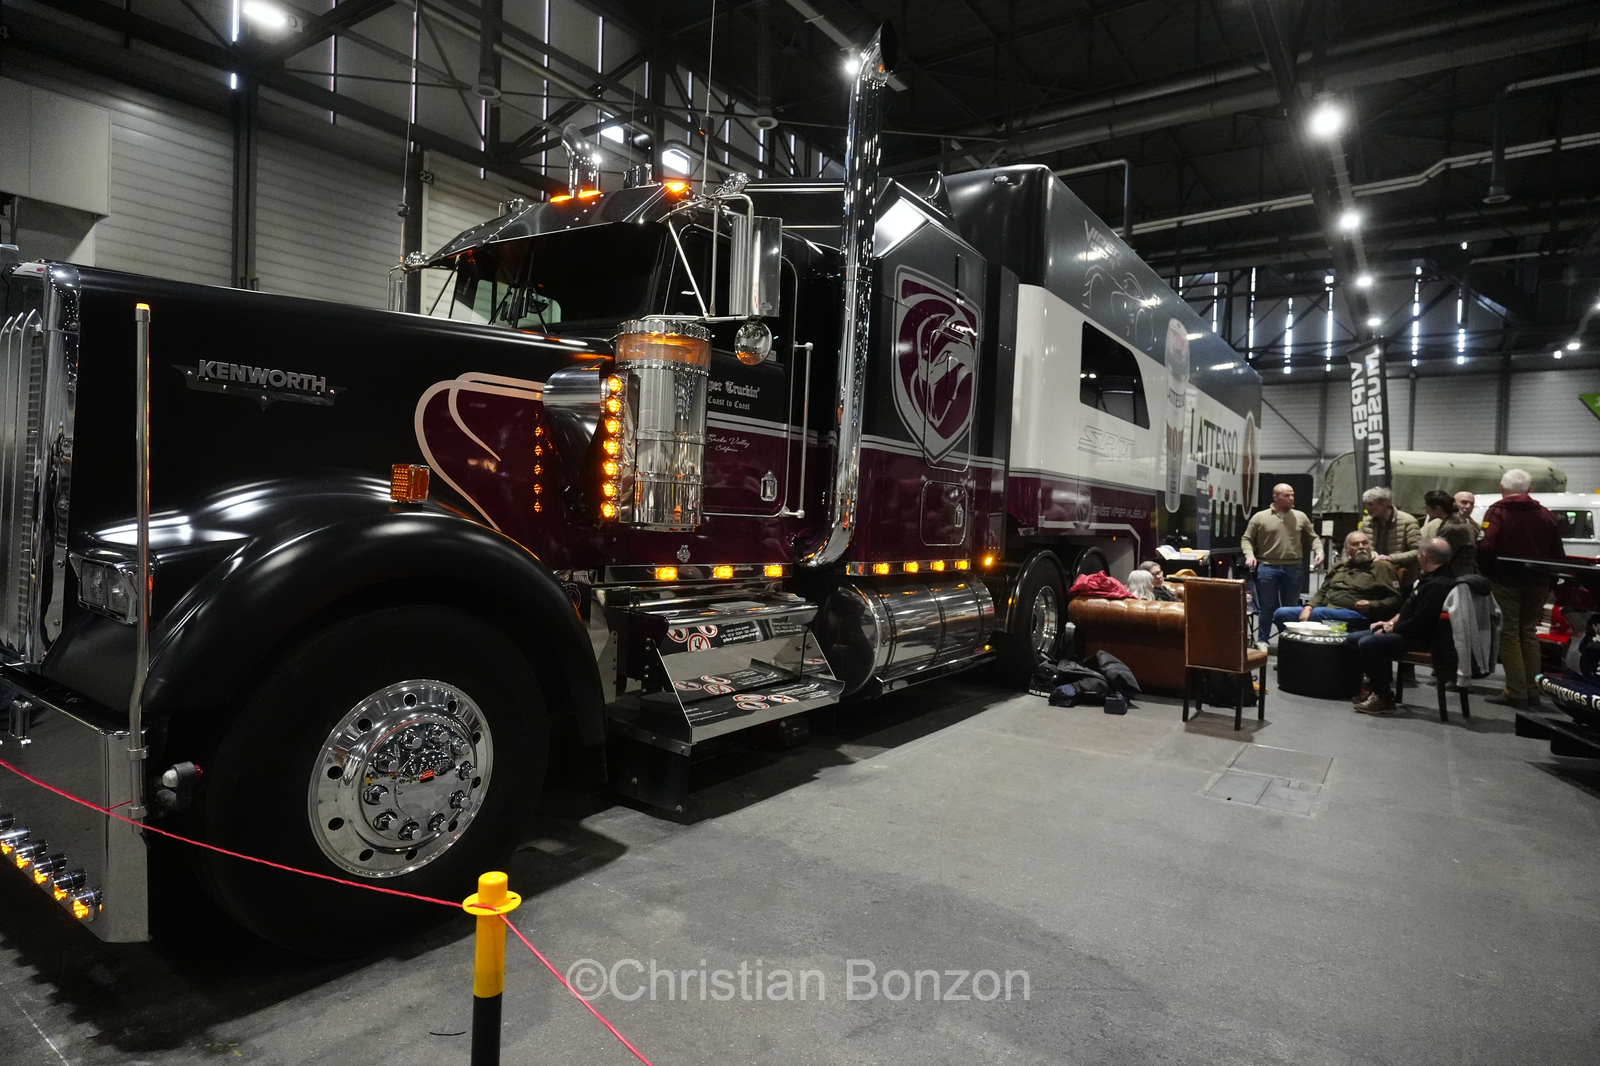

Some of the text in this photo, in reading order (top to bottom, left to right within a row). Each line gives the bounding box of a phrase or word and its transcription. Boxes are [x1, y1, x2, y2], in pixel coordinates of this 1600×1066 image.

[420, 170, 433, 184] 22
[199, 359, 326, 393] KENWORTH
[708, 396, 724, 406] Coast
[734, 401, 750, 410] Coast
[1078, 425, 1135, 462] SRT
[1189, 407, 1238, 475] LATTESSO
[1542, 678, 1588, 706] Bouygues
